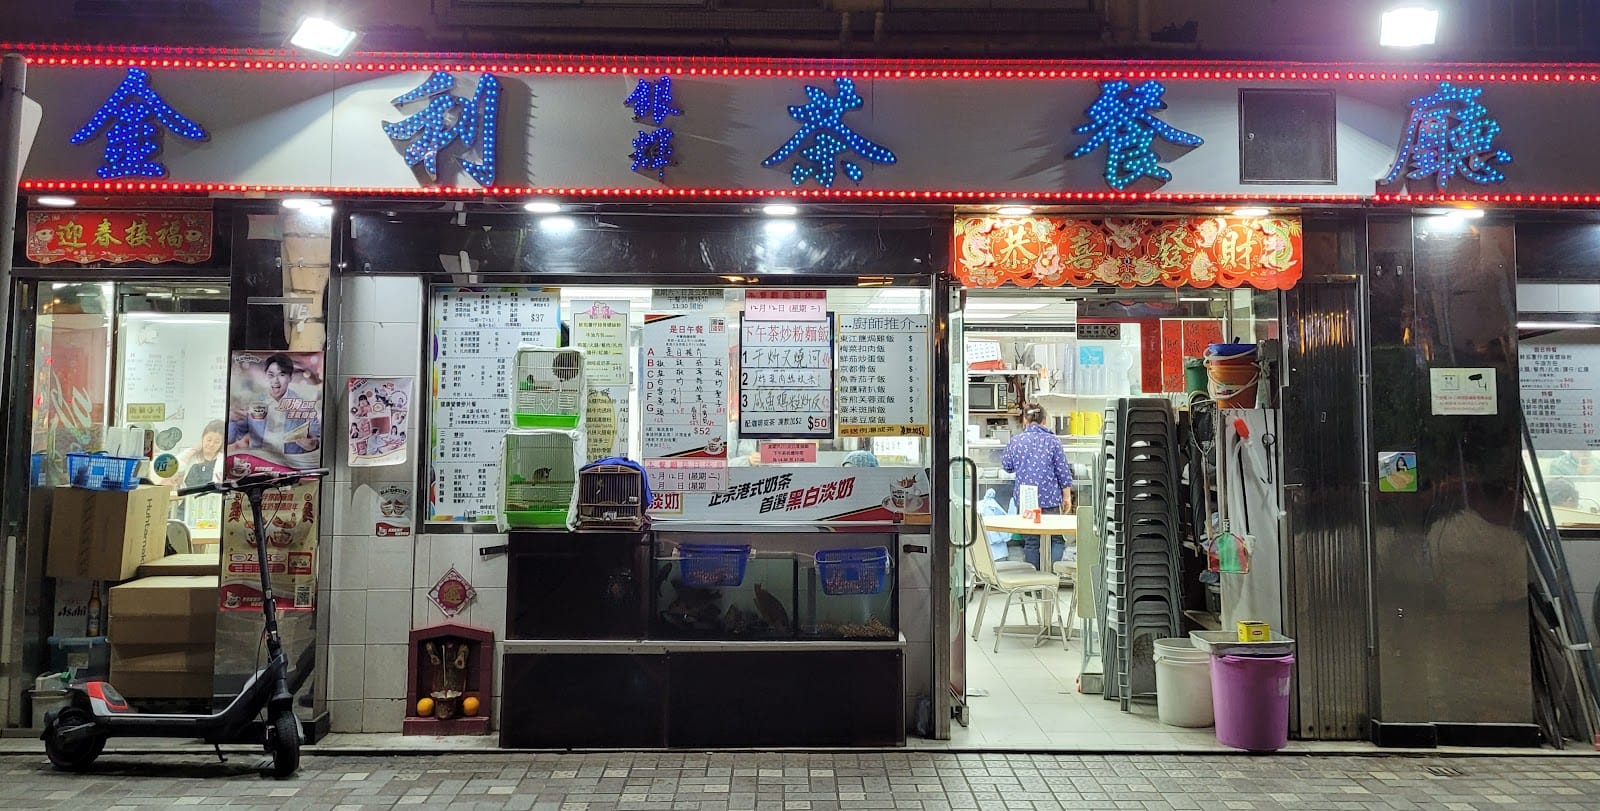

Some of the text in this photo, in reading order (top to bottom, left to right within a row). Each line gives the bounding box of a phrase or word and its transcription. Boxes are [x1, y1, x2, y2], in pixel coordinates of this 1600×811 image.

[56, 218, 186, 250] 迎春接福
[999, 224, 1258, 271] 恭喜發財
[531, 314, 544, 323] $37
[669, 325, 704, 334] 是日午餐
[743, 325, 829, 343] 下午茶炒粉麵飯
[647, 348, 655, 356] A
[647, 370, 654, 378] C
[646, 404, 654, 412] G
[808, 416, 828, 431] $50
[694, 428, 710, 436] $52
[708, 472, 793, 507] 正宗港式奶茶
[759, 477, 857, 514] 首選黑白淡奶
[57, 607, 87, 617] Asahi
